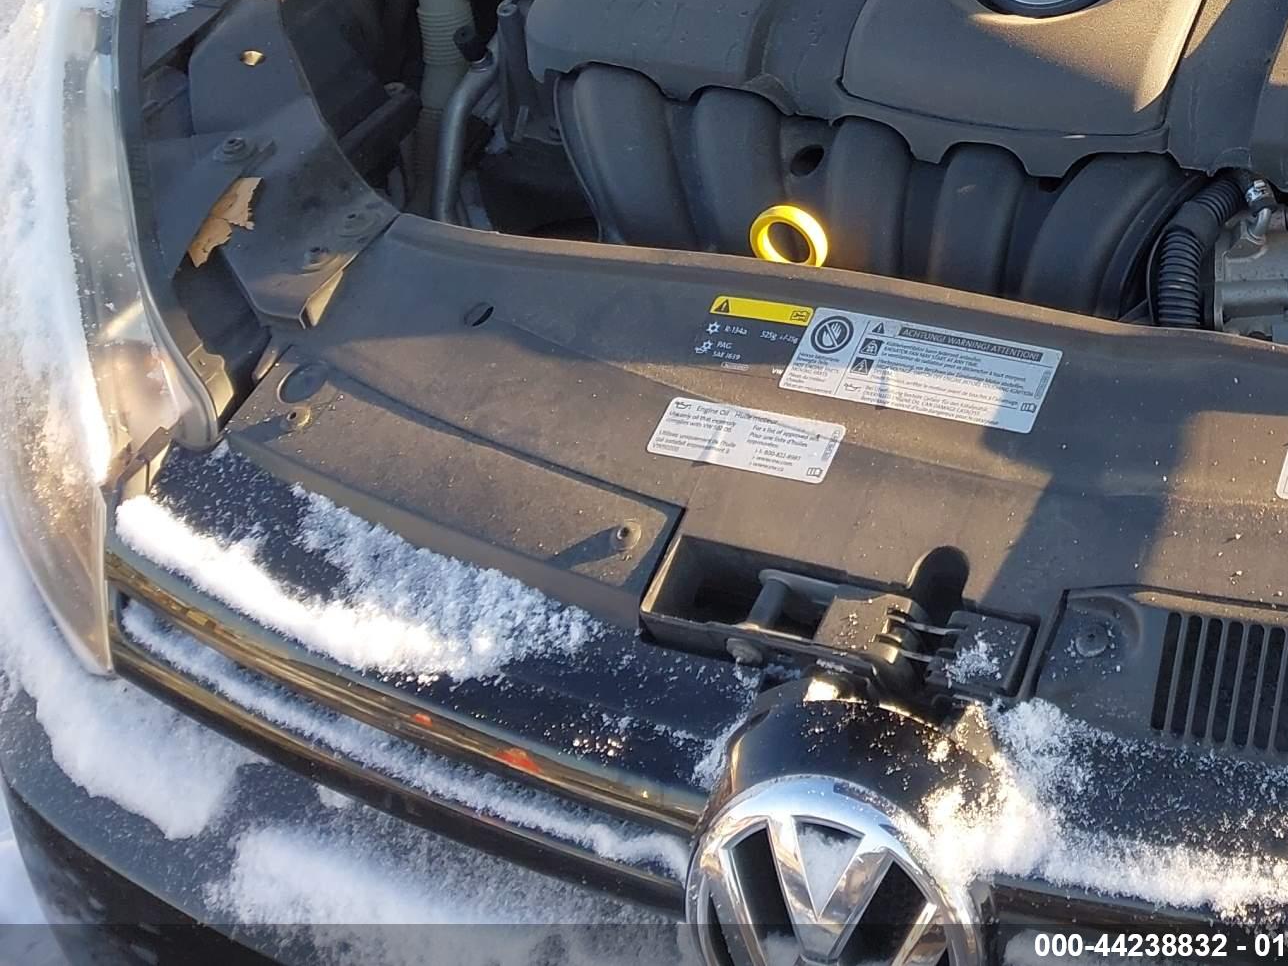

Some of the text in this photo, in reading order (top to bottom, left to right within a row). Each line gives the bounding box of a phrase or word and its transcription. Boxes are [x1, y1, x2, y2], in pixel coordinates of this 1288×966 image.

[902, 329, 946, 342] ACHTUNG!
[946, 337, 990, 350] WARNING!
[990, 345, 1040, 360] ATTENTION!
[695, 405, 719, 415] Engine
